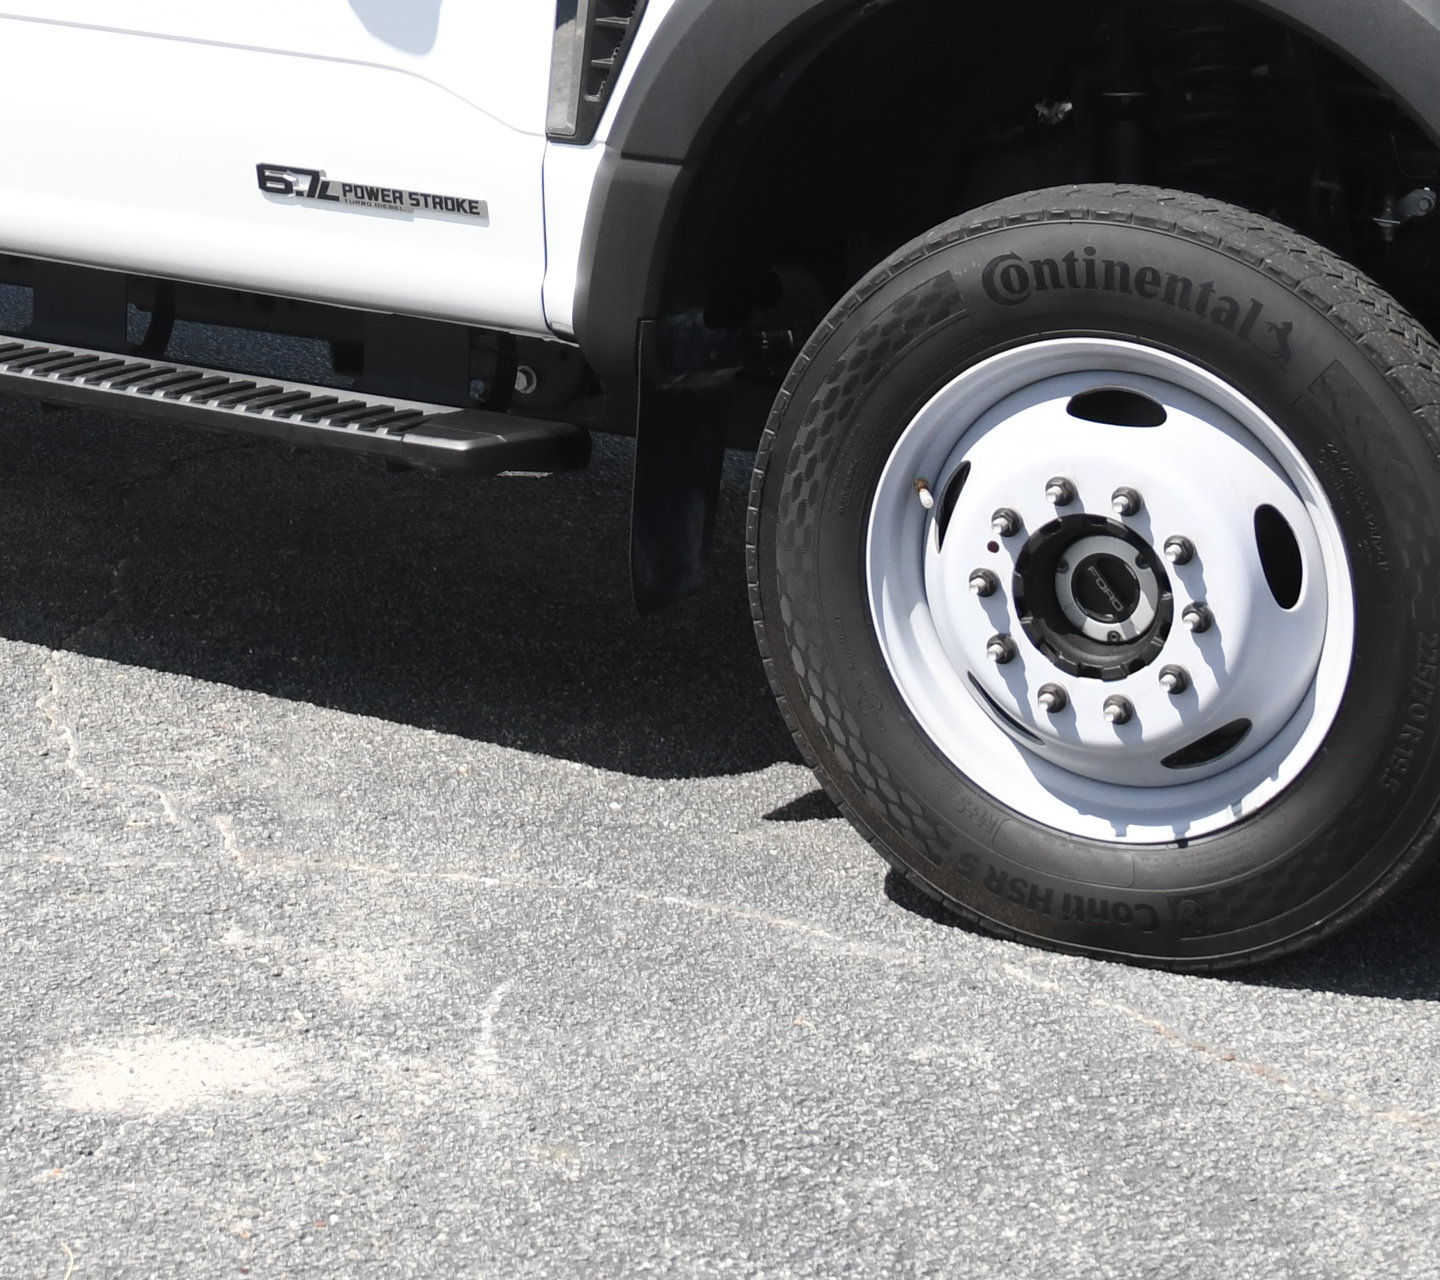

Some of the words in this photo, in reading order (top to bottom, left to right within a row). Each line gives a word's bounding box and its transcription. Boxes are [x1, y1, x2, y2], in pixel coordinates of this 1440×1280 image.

[256, 163, 340, 201] 6.7L
[341, 183, 405, 206] POWER
[409, 191, 481, 216] STROKE
[343, 198, 373, 208] TURBO
[981, 245, 1264, 340] Continental
[1087, 565, 1123, 612] FORD
[983, 865, 1055, 916] HSR
[1062, 893, 1160, 933] Conti
